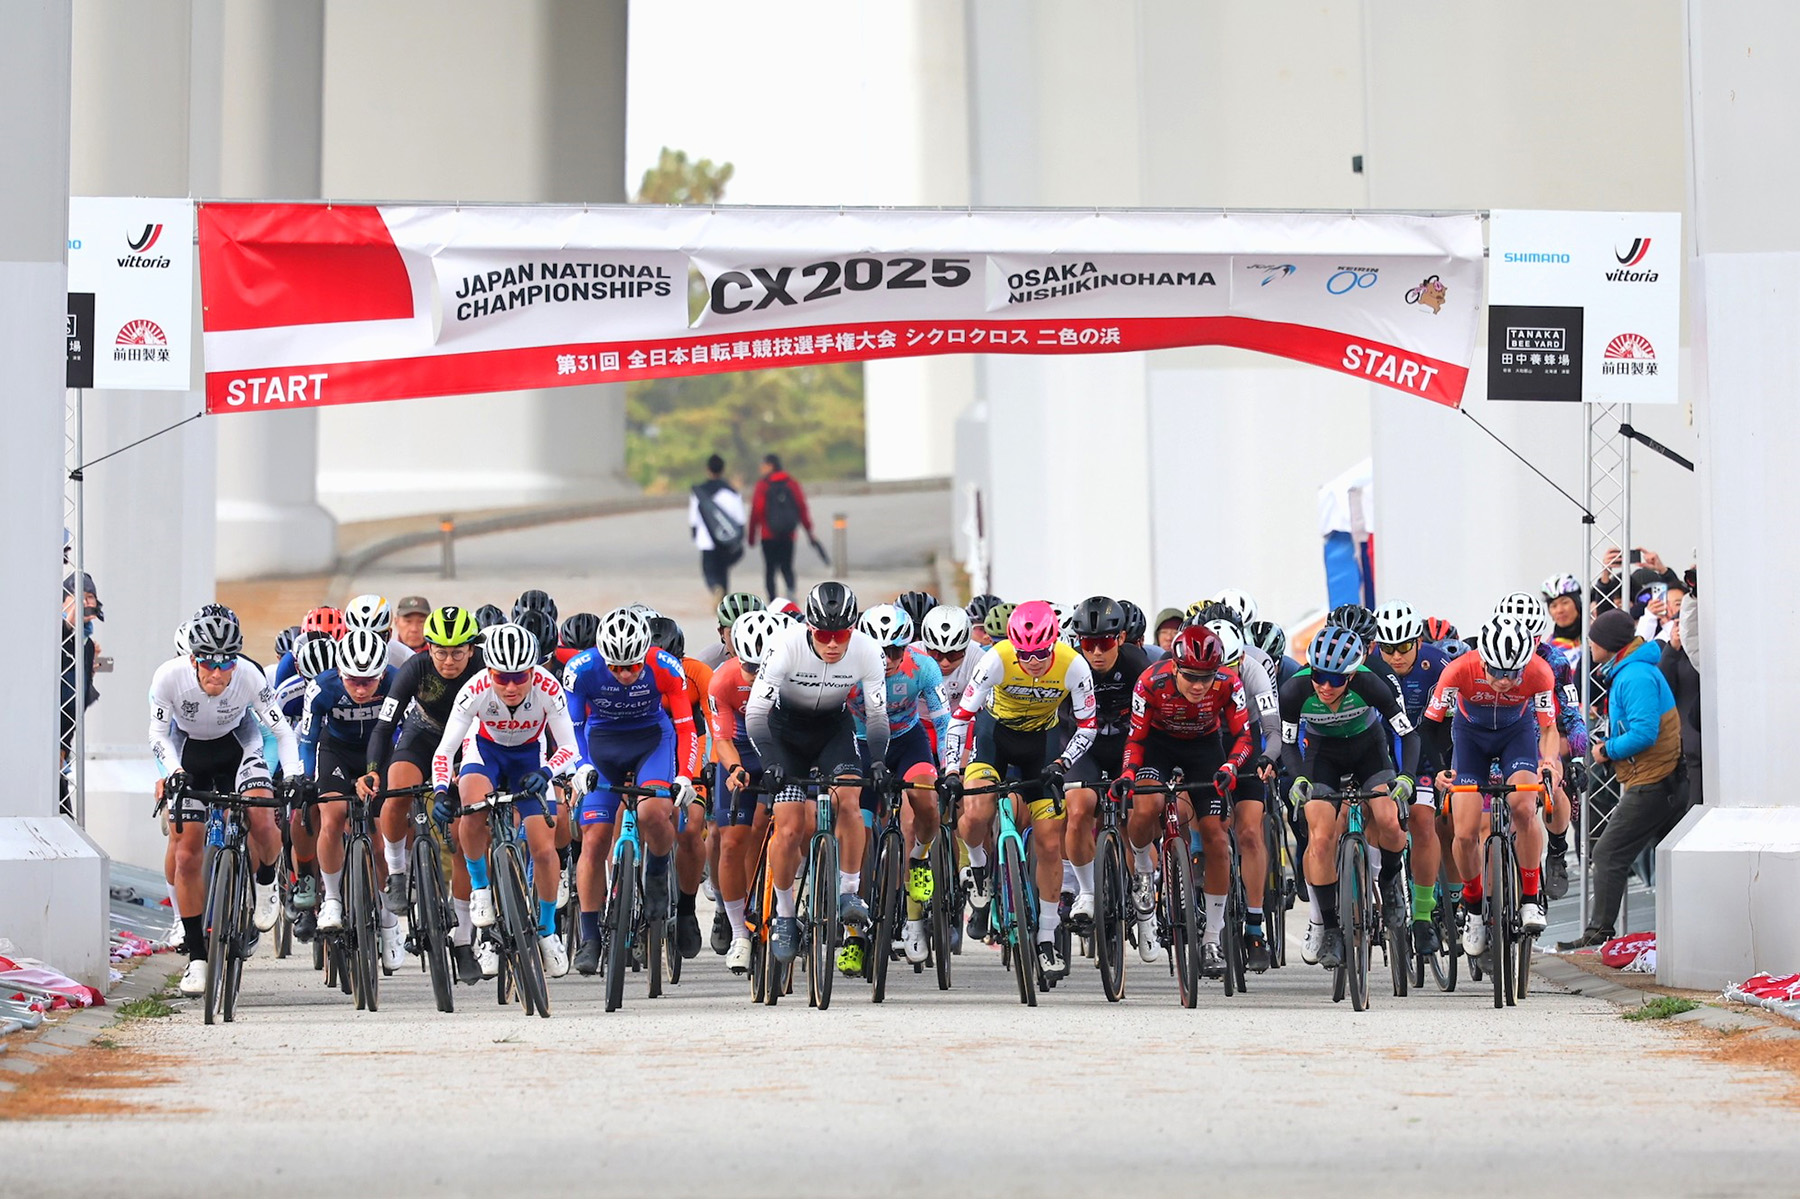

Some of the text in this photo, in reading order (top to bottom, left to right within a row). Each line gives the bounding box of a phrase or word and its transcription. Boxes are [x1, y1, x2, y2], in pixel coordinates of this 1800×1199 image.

[117, 255, 171, 268] vittoria
[1504, 252, 1570, 264] SHIMANO
[455, 263, 671, 299] JAPAN NATIONAL
[1007, 262, 1098, 290] OSAKA
[1605, 269, 1659, 283] vittoria
[1007, 272, 1216, 304] NISHIKINOHAMA
[456, 281, 671, 321] CHAMPIONSHIPS
[1510, 330, 1560, 339] TANAKA
[1511, 340, 1560, 348] BEE YARD
[113, 348, 170, 361] 前田製菓
[556, 327, 1121, 375] 第31回 全日本自転車競技選手権大会 シクロクロス 二色の浜
[1501, 353, 1570, 366] 田中養蜂場
[1342, 345, 1439, 391] START
[1602, 362, 1659, 376] 前田製菓
[226, 373, 328, 406] START
[564, 674, 570, 686] 6
[765, 686, 775, 699] 2
[875, 692, 884, 706] 2
[458, 694, 469, 705] 7
[1133, 700, 1140, 712] 3
[1260, 695, 1274, 709] 21
[1540, 695, 1548, 708] 5
[157, 708, 164, 720] 8
[269, 709, 280, 723] 8
[303, 720, 310, 732] 4
[485, 720, 540, 730] PEDAL
[1398, 718, 1408, 729] 4
[1285, 728, 1292, 739] 4
[548, 748, 575, 769] PEDAL
[434, 755, 449, 783] PEDAL
